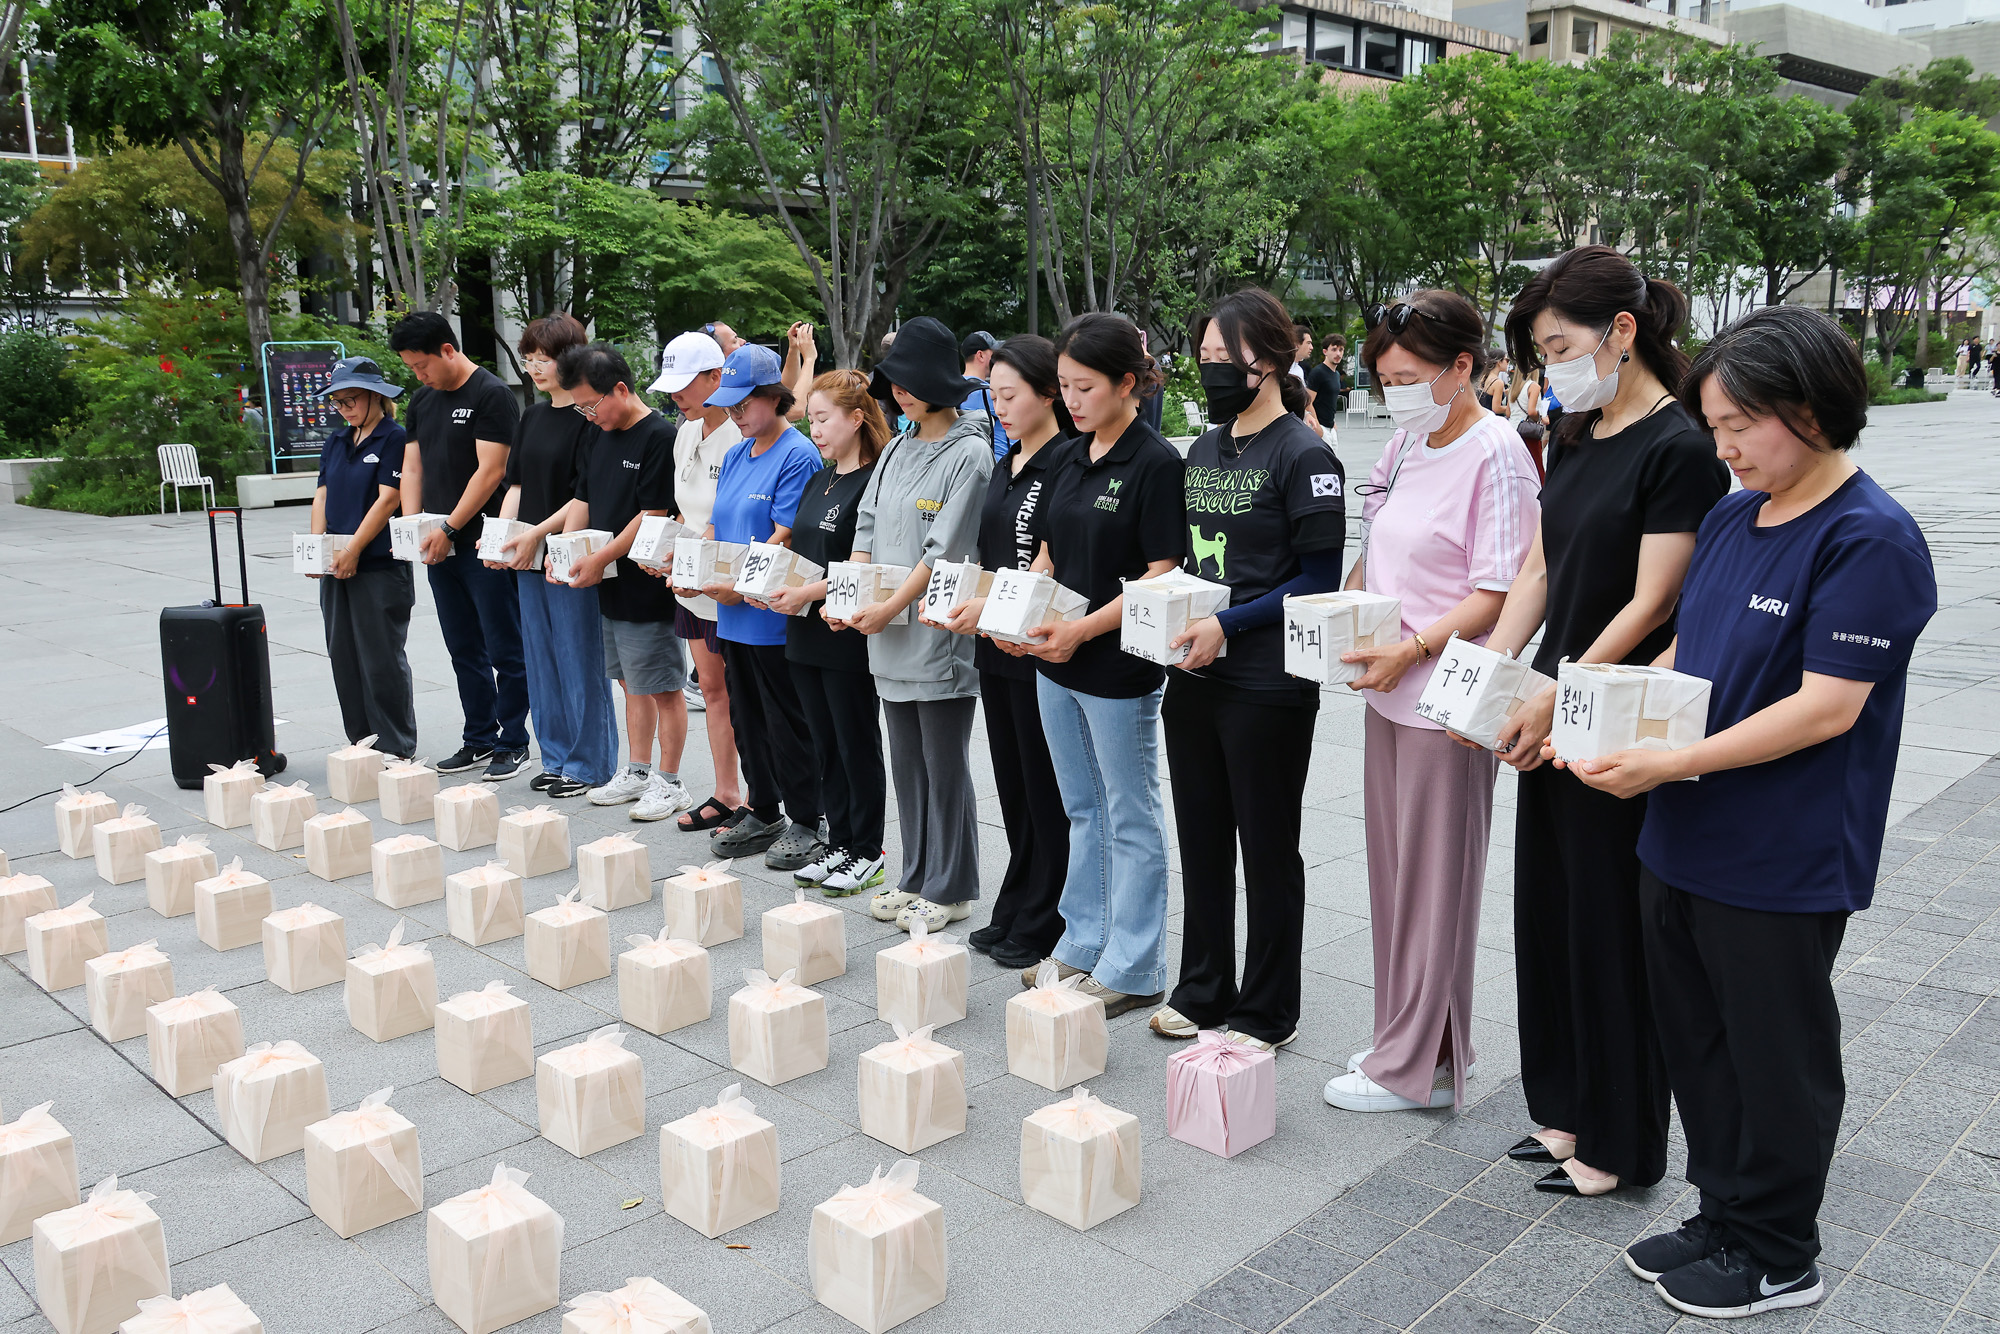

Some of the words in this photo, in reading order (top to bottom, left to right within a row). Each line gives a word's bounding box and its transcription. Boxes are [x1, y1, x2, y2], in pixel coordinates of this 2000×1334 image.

[451, 408, 474, 419] CDT
[1092, 500, 1119, 513] RESCUE
[296, 541, 315, 560] 이안
[928, 570, 960, 608] 동백
[1129, 603, 1156, 629] 비즈
[1289, 619, 1322, 660] 해피
[1831, 631, 1870, 645] 동물권행동
[1870, 637, 1891, 650] 카라
[1443, 658, 1481, 696] 구마
[1561, 684, 1594, 731] 복실이
